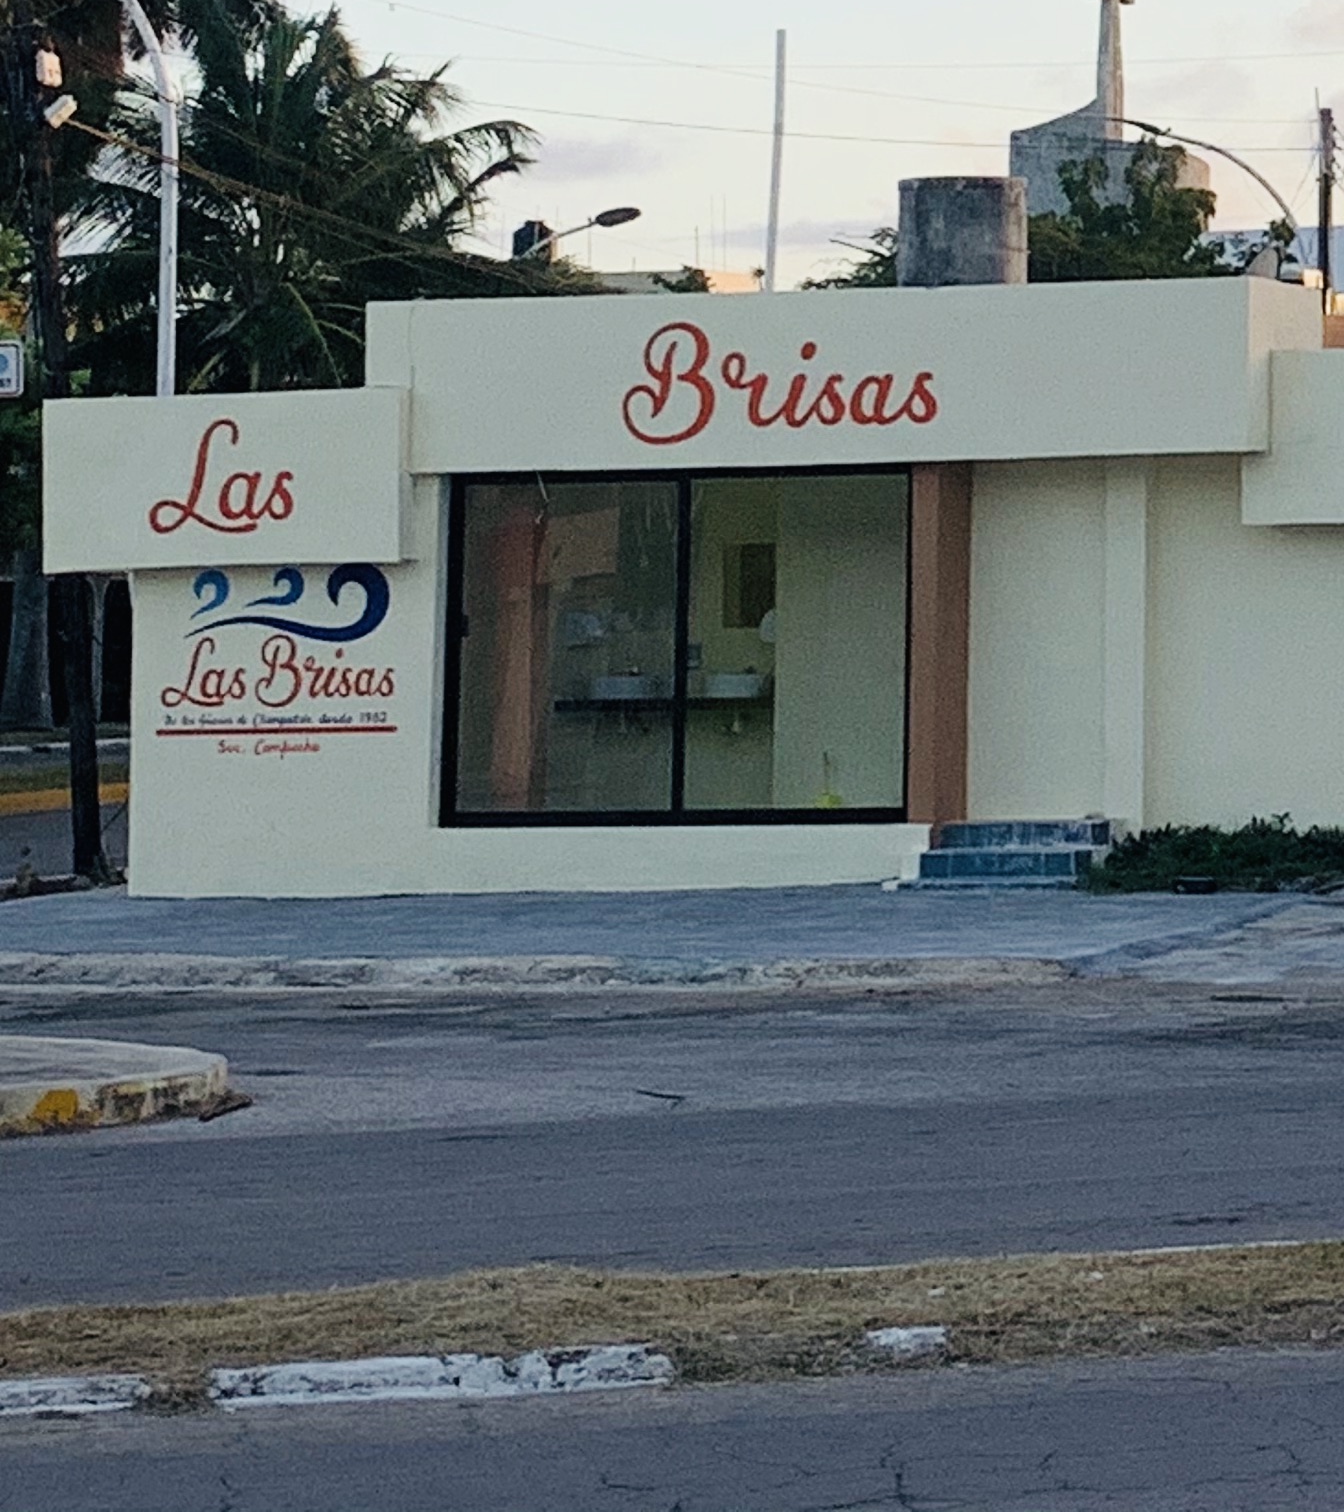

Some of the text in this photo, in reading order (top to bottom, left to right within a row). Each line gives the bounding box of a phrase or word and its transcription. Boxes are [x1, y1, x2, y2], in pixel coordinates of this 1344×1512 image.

[622, 320, 938, 446] Brisas
[149, 418, 294, 534] Las
[160, 634, 395, 708] Las Brisas
[254, 737, 320, 760] Campeche
